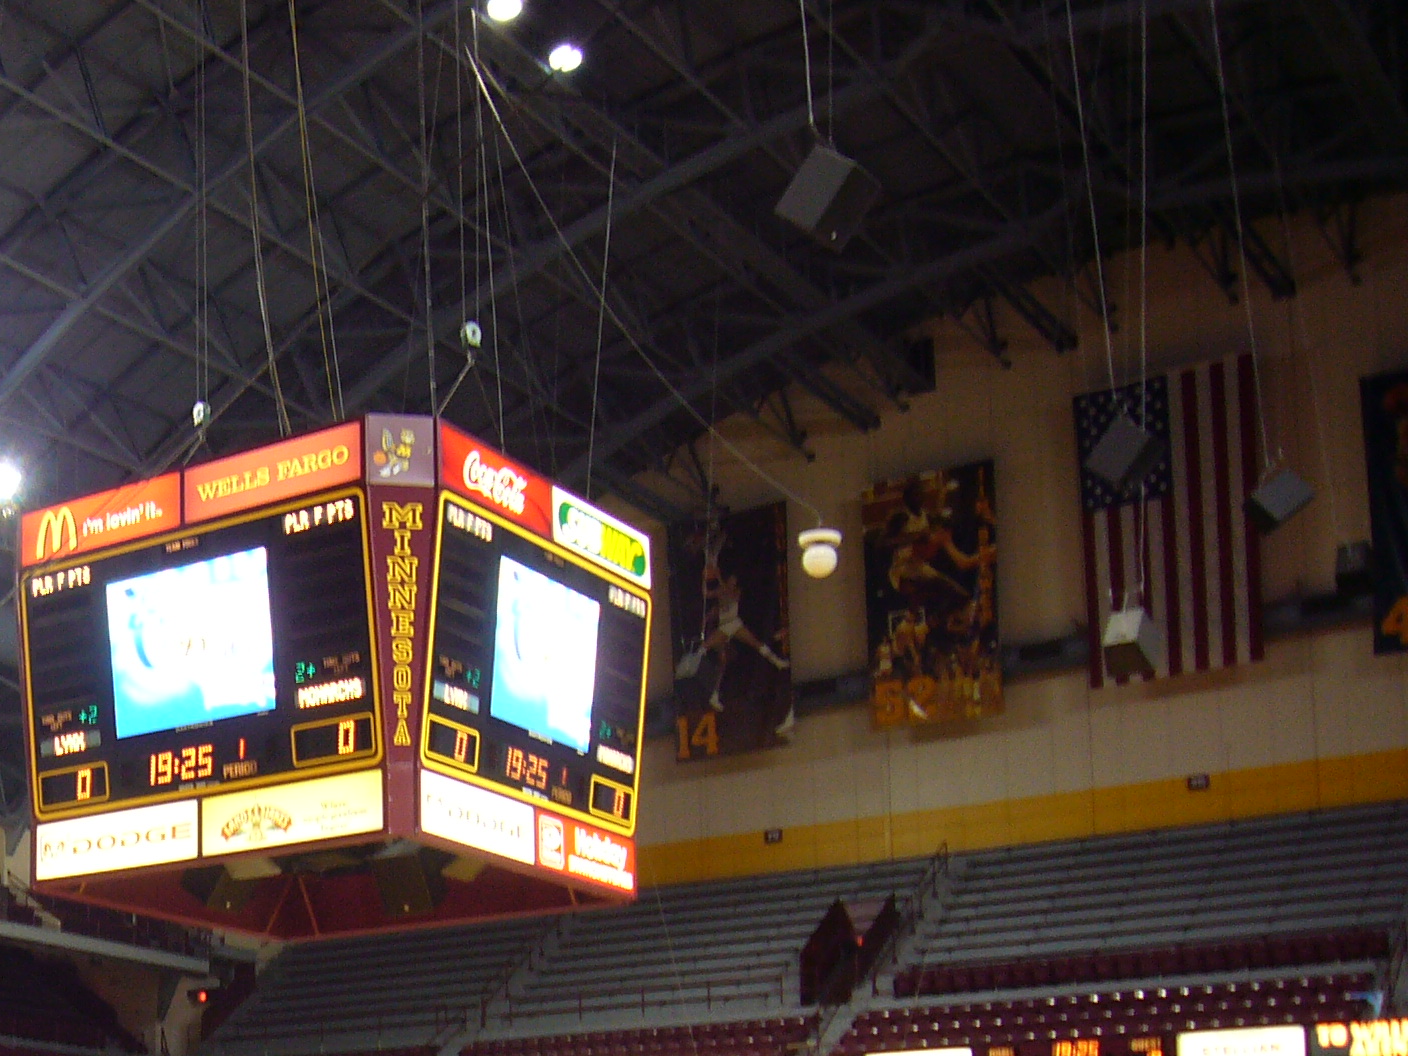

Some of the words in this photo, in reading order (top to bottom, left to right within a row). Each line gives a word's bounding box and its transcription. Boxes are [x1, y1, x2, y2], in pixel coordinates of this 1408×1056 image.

[197, 467, 270, 503] WELLS
[277, 445, 349, 482] FARGO
[382, 501, 423, 746] MINNESOTA
[54, 730, 85, 756] LYNX
[338, 719, 354, 754] 0
[454, 729, 468, 762] 0
[677, 712, 720, 761] 14
[77, 768, 91, 800] 0
[150, 744, 213, 786] 19:25
[505, 746, 548, 790] 19:25
[72, 823, 192, 855] DODGE
